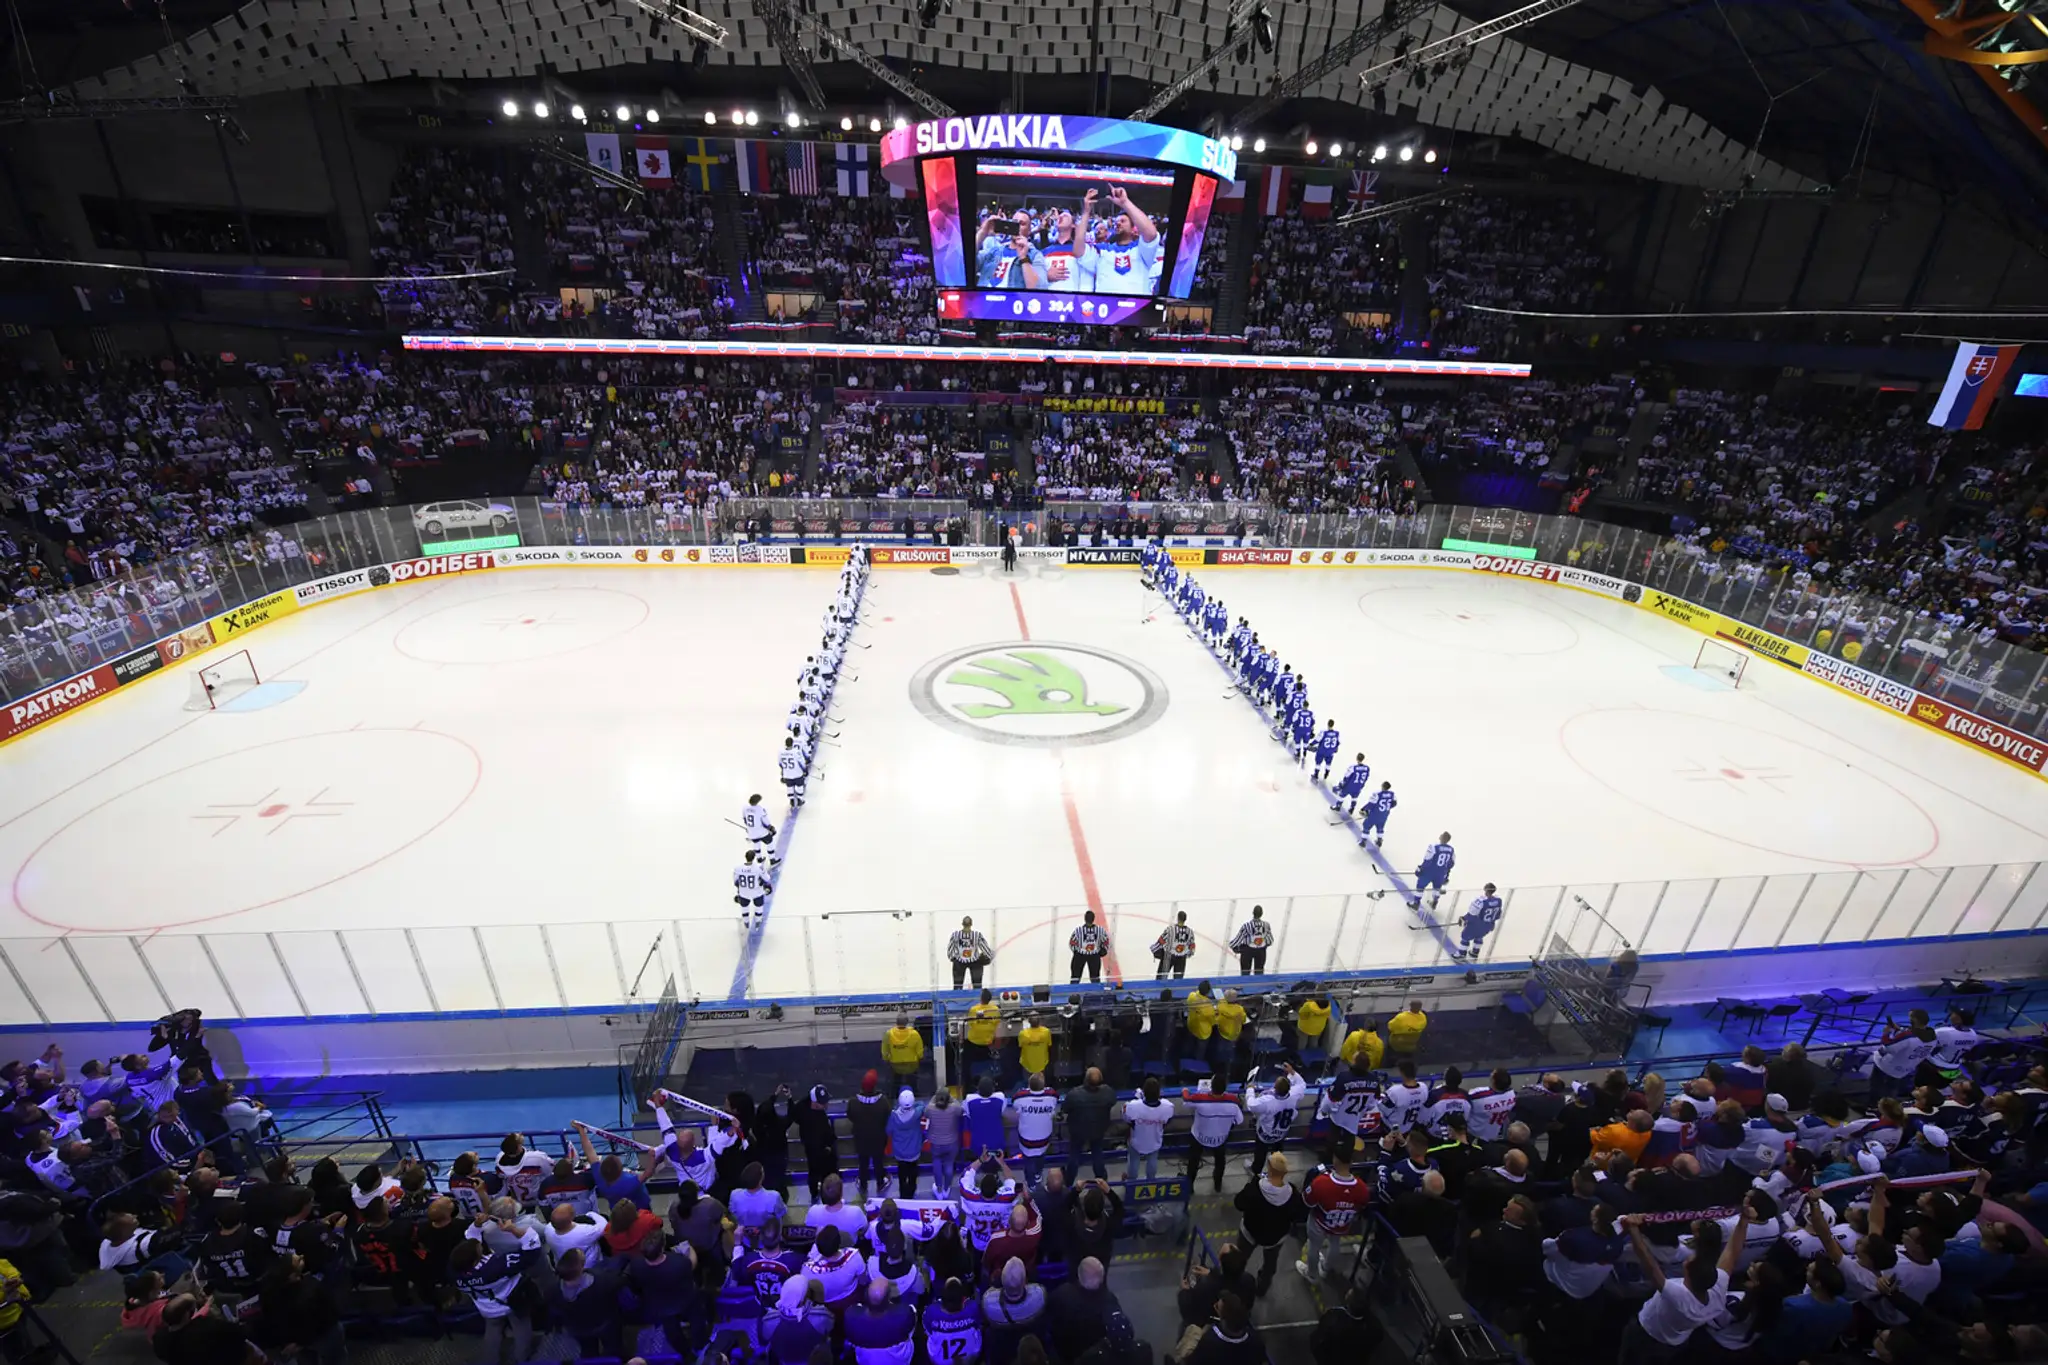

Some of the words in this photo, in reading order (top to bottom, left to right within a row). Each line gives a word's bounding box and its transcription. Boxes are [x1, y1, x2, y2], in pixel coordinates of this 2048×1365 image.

[916, 116, 1067, 154] SLOVAKIA
[1013, 300, 1024, 314] 0
[1098, 304, 1108, 318] 0
[515, 551, 560, 561] ŠKODA
[580, 551, 622, 560] ŠKODA
[893, 548, 947, 562] KRUŠOVICE
[1069, 552, 1107, 561] NIVEA
[1110, 552, 1142, 561] MEN
[1380, 552, 1415, 561] ŠKODA
[1433, 554, 1471, 565] ŠKODA
[394, 551, 493, 581] ФОНБЕТ
[1473, 555, 1561, 581] ФОНБЕТ
[315, 573, 364, 593] TISSOT
[1581, 573, 1623, 590] TISSOT
[239, 595, 283, 617] Raiffeisen
[1671, 599, 1710, 620] Raiffeisen
[243, 610, 270, 628] BANK
[1668, 607, 1692, 623] BANK
[1809, 653, 1840, 670] LIQUI
[1805, 662, 1835, 681] MOLY
[1843, 667, 1875, 686] LIQUI
[1838, 675, 1870, 696] MOLY
[1878, 681, 1912, 701] LIQUI
[10, 674, 97, 724] PATRON
[1874, 690, 1907, 712] MOLY
[1323, 737, 1337, 748] 23
[1944, 712, 2044, 765] KRUŠOVICE
[781, 757, 795, 769] 55
[739, 874, 756, 889] 88
[1484, 907, 1500, 923] 27
[1274, 1109, 1294, 1130] 18
[1157, 1184, 1181, 1197] 15
[1644, 1207, 1736, 1224] SLOVENSKO
[219, 1259, 250, 1278] 11
[942, 1339, 968, 1361] 12
